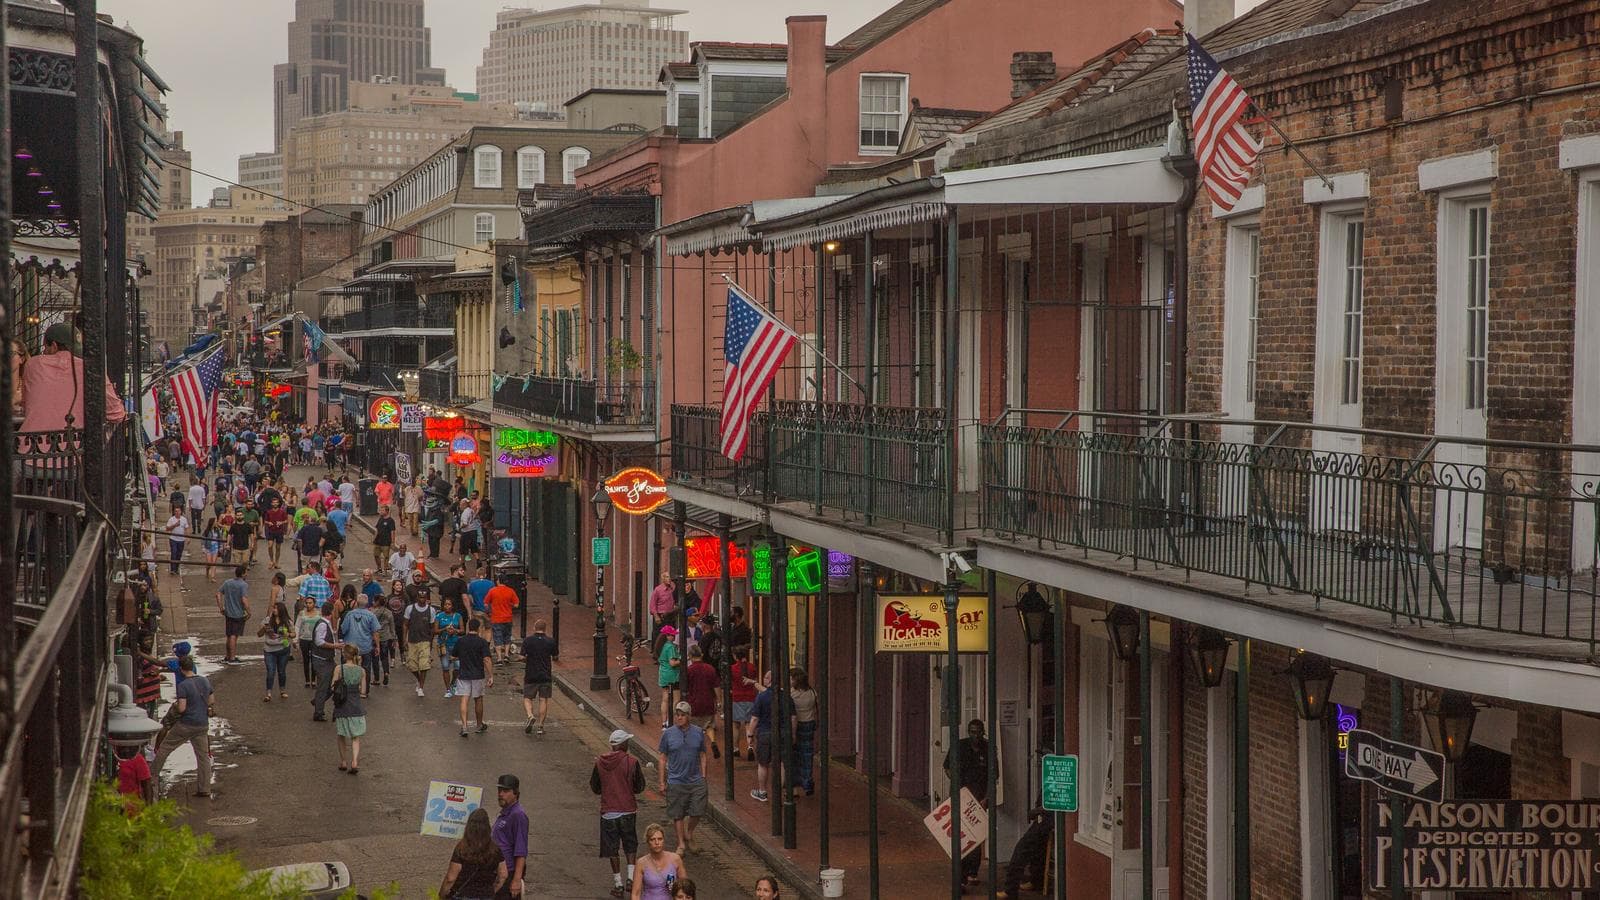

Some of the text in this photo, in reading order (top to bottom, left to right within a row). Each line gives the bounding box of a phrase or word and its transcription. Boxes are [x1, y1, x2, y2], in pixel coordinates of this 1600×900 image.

[498, 430, 557, 446] JESTER
[929, 602, 938, 612] @
[945, 608, 984, 627] ar
[883, 625, 942, 641] TICKLERS
[1363, 746, 1412, 779] ONE WAY
[426, 797, 446, 822] 2
[1418, 831, 1540, 846] DEDICATED
[1551, 831, 1582, 846] TO
